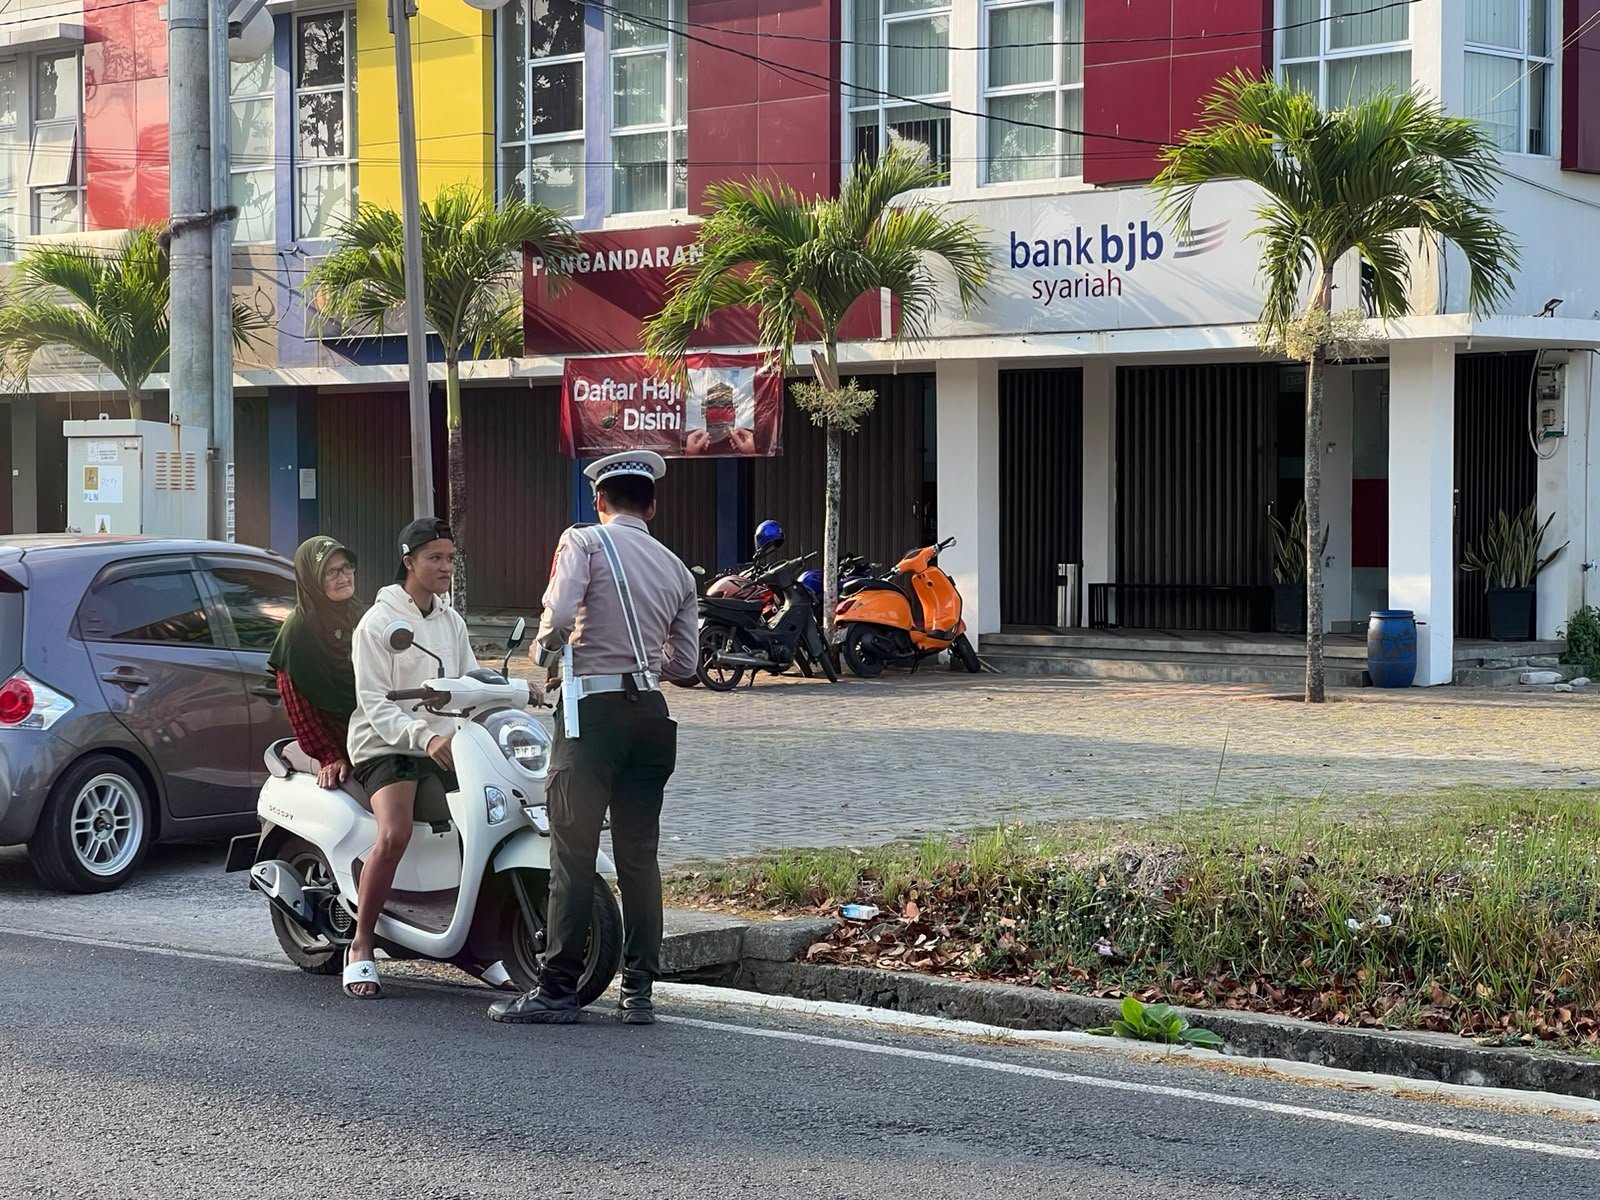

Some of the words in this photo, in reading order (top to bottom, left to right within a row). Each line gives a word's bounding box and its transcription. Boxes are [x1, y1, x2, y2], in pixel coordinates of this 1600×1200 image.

[1010, 226, 1094, 269] bank
[1101, 220, 1164, 271] bjb
[1032, 269, 1122, 306] syariah
[573, 378, 638, 402] Daftar
[642, 375, 681, 405] Haji
[623, 404, 681, 431] Disini
[83, 493, 99, 501] PLN
[526, 809, 538, 819] Z
